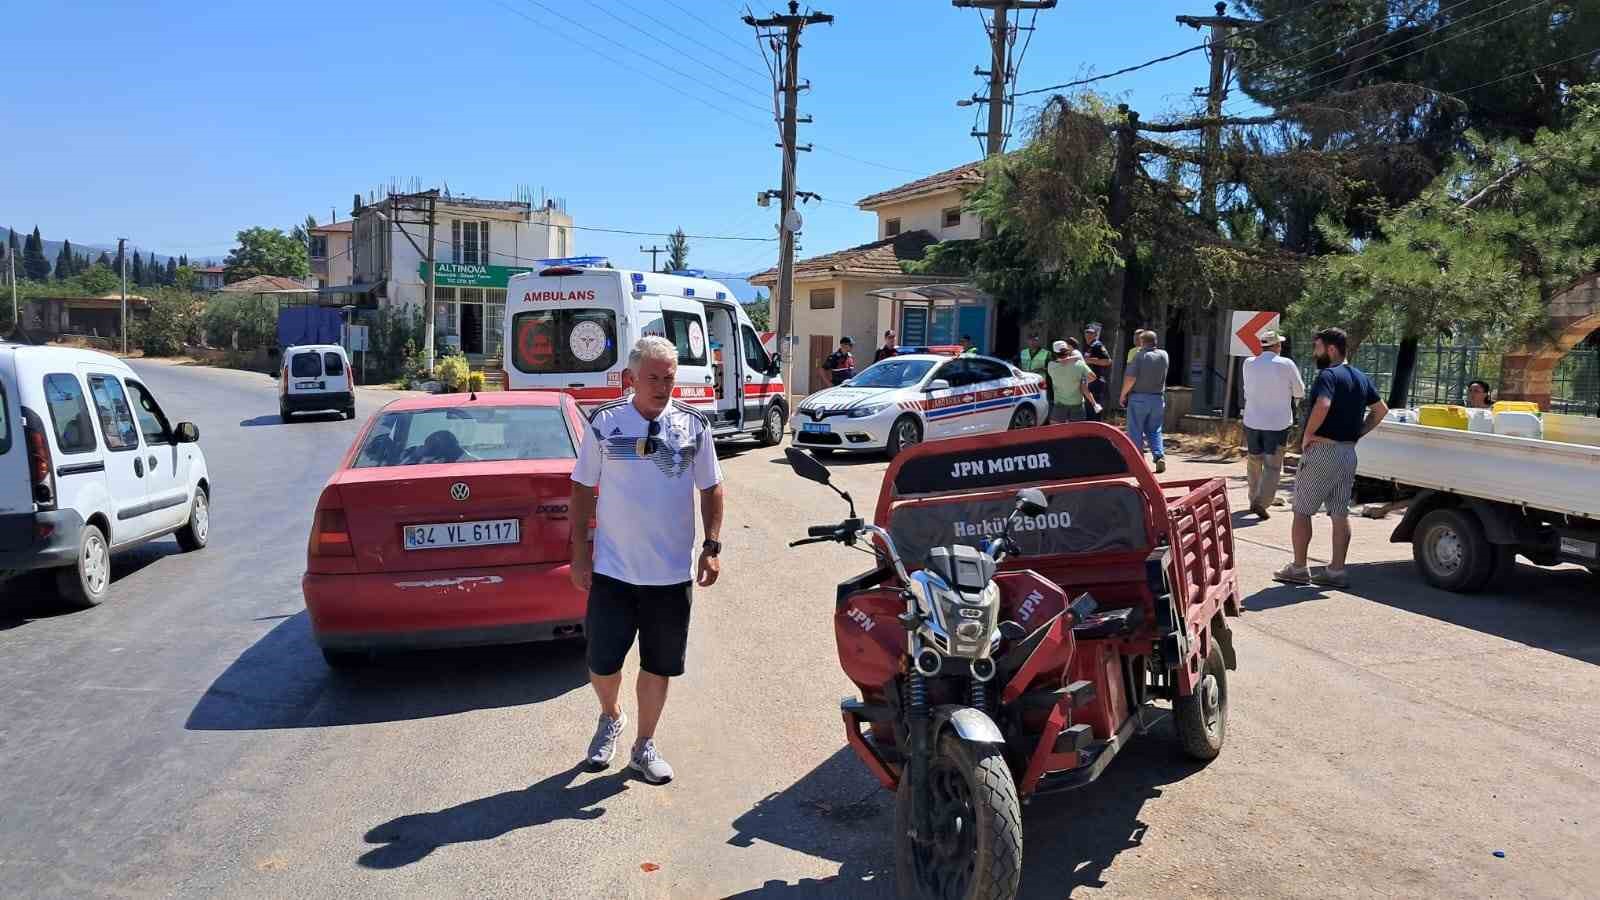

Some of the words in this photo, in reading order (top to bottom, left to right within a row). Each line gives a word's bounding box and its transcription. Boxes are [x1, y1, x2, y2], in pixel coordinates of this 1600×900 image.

[439, 264, 486, 274] ALTINOVA
[523, 290, 595, 302] AMBULANS
[951, 460, 985, 478] JPN
[987, 453, 1052, 474] MOTOR
[416, 528, 436, 545] 34
[447, 525, 466, 543] VL
[473, 522, 512, 541] 6117
[1013, 512, 1072, 532] 25000
[1018, 590, 1044, 621] JPN
[847, 608, 876, 632] JPN
